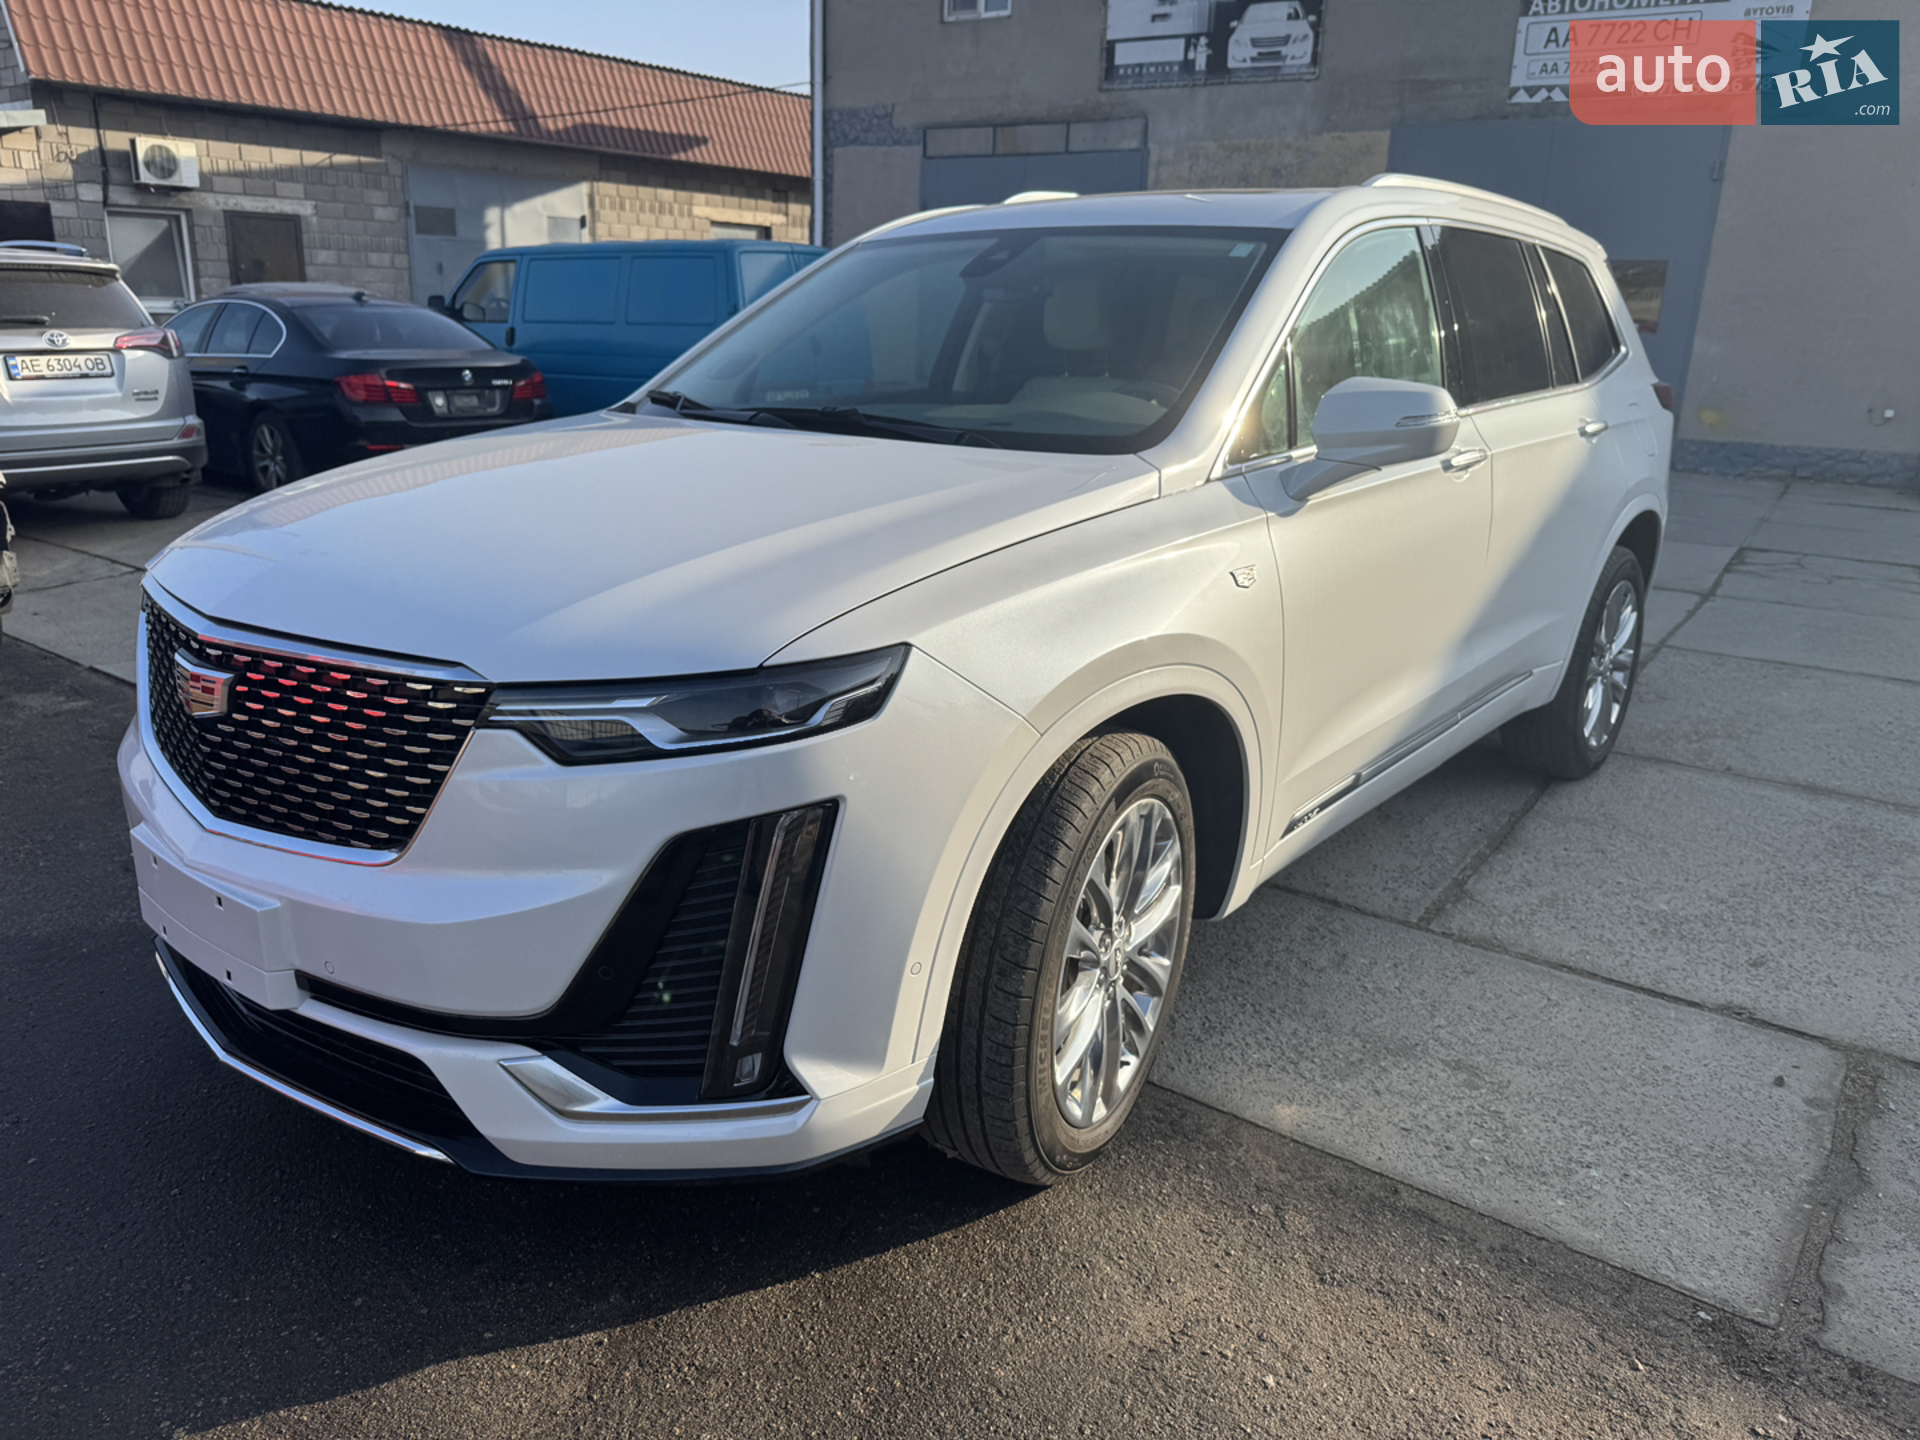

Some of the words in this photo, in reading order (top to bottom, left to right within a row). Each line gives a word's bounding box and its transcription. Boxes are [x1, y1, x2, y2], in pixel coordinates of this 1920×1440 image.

[1529, 0, 1704, 16] АВТОНО
[1543, 26, 1579, 49] AA
[1587, 21, 1647, 46] 7722
[1653, 17, 1693, 42] CH
[1539, 62, 1559, 75] AA
[20, 359, 43, 373] AE
[46, 357, 83, 372] 6304
[84, 357, 106, 371] OB
[1056, 875, 1082, 945] PRIMACY
